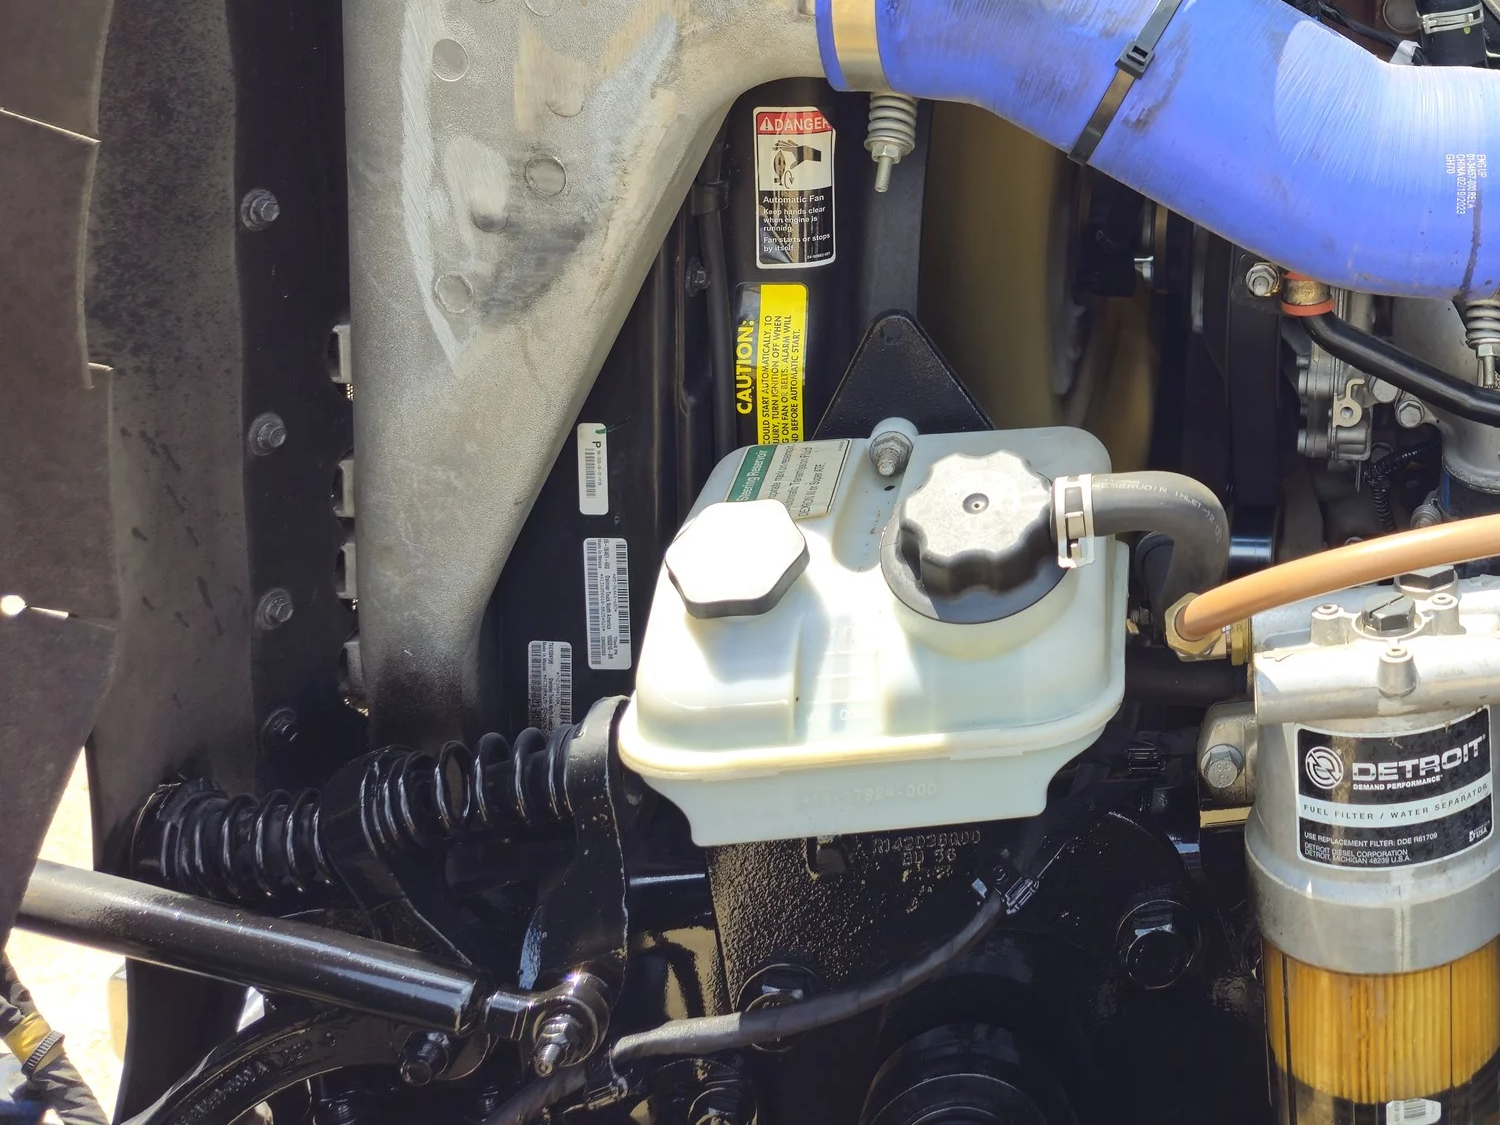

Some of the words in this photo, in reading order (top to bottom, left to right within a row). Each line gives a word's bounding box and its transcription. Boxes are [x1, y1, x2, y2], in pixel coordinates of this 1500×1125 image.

[1456, 154, 1466, 177] CHINA
[1477, 154, 1487, 168] ENG
[763, 195, 807, 205] Automatic
[809, 195, 825, 203] Fan
[1456, 177, 1466, 214] 02/19/2023
[763, 208, 782, 216] Keep
[784, 207, 807, 215] hands
[808, 206, 826, 215] clear
[763, 216, 784, 224] when
[785, 216, 810, 225] engine
[763, 225, 794, 234] running.
[763, 236, 777, 244] Fan
[779, 235, 801, 243] starts
[812, 234, 831, 242] stops
[763, 245, 773, 253] by
[774, 244, 796, 253] itself.
[764, 315, 772, 326] TO
[773, 315, 782, 341] WHEN
[783, 315, 792, 334] WILL
[792, 329, 800, 353] START.
[772, 343, 780, 358] OFF
[781, 335, 790, 363] ALARM
[736, 319, 755, 414] CAUTION:
[761, 329, 772, 394] AUTOMATICALLY.
[771, 360, 779, 395] IGNITION
[790, 355, 799, 401] AUTOMATIC
[781, 390, 788, 404] OR
[762, 396, 770, 418] START
[781, 405, 789, 421] FAN
[763, 420, 771, 445] COULD
[782, 422, 789, 436] ON
[801, 447, 812, 458] Fluid
[747, 450, 768, 478] Reservoir
[809, 472, 824, 486] Super
[736, 476, 760, 501] Steering
[1352, 735, 1483, 781] DETROIT
[1353, 783, 1385, 791] DEMAND
[1386, 776, 1441, 790] PERFORMANCE
[1303, 804, 1328, 816] FUEL
[1334, 810, 1374, 820] FILTER
[1390, 807, 1429, 819] WATER
[1434, 782, 1488, 811] SEPARATOR
[1304, 832, 1317, 841] USE
[1317, 834, 1368, 847] REPLACEMENT
[1369, 838, 1395, 847] FILTER:
[1397, 837, 1412, 846] DDE
[1304, 842, 1331, 854] DETROIT
[1331, 848, 1355, 856] DIESEL
[1356, 848, 1408, 857] CORPORATION
[1304, 849, 1332, 861] DETROIT,
[1333, 854, 1368, 864] MICHIGAN
[1369, 856, 1390, 864] 48239
[1391, 854, 1411, 864] U.S.A.
